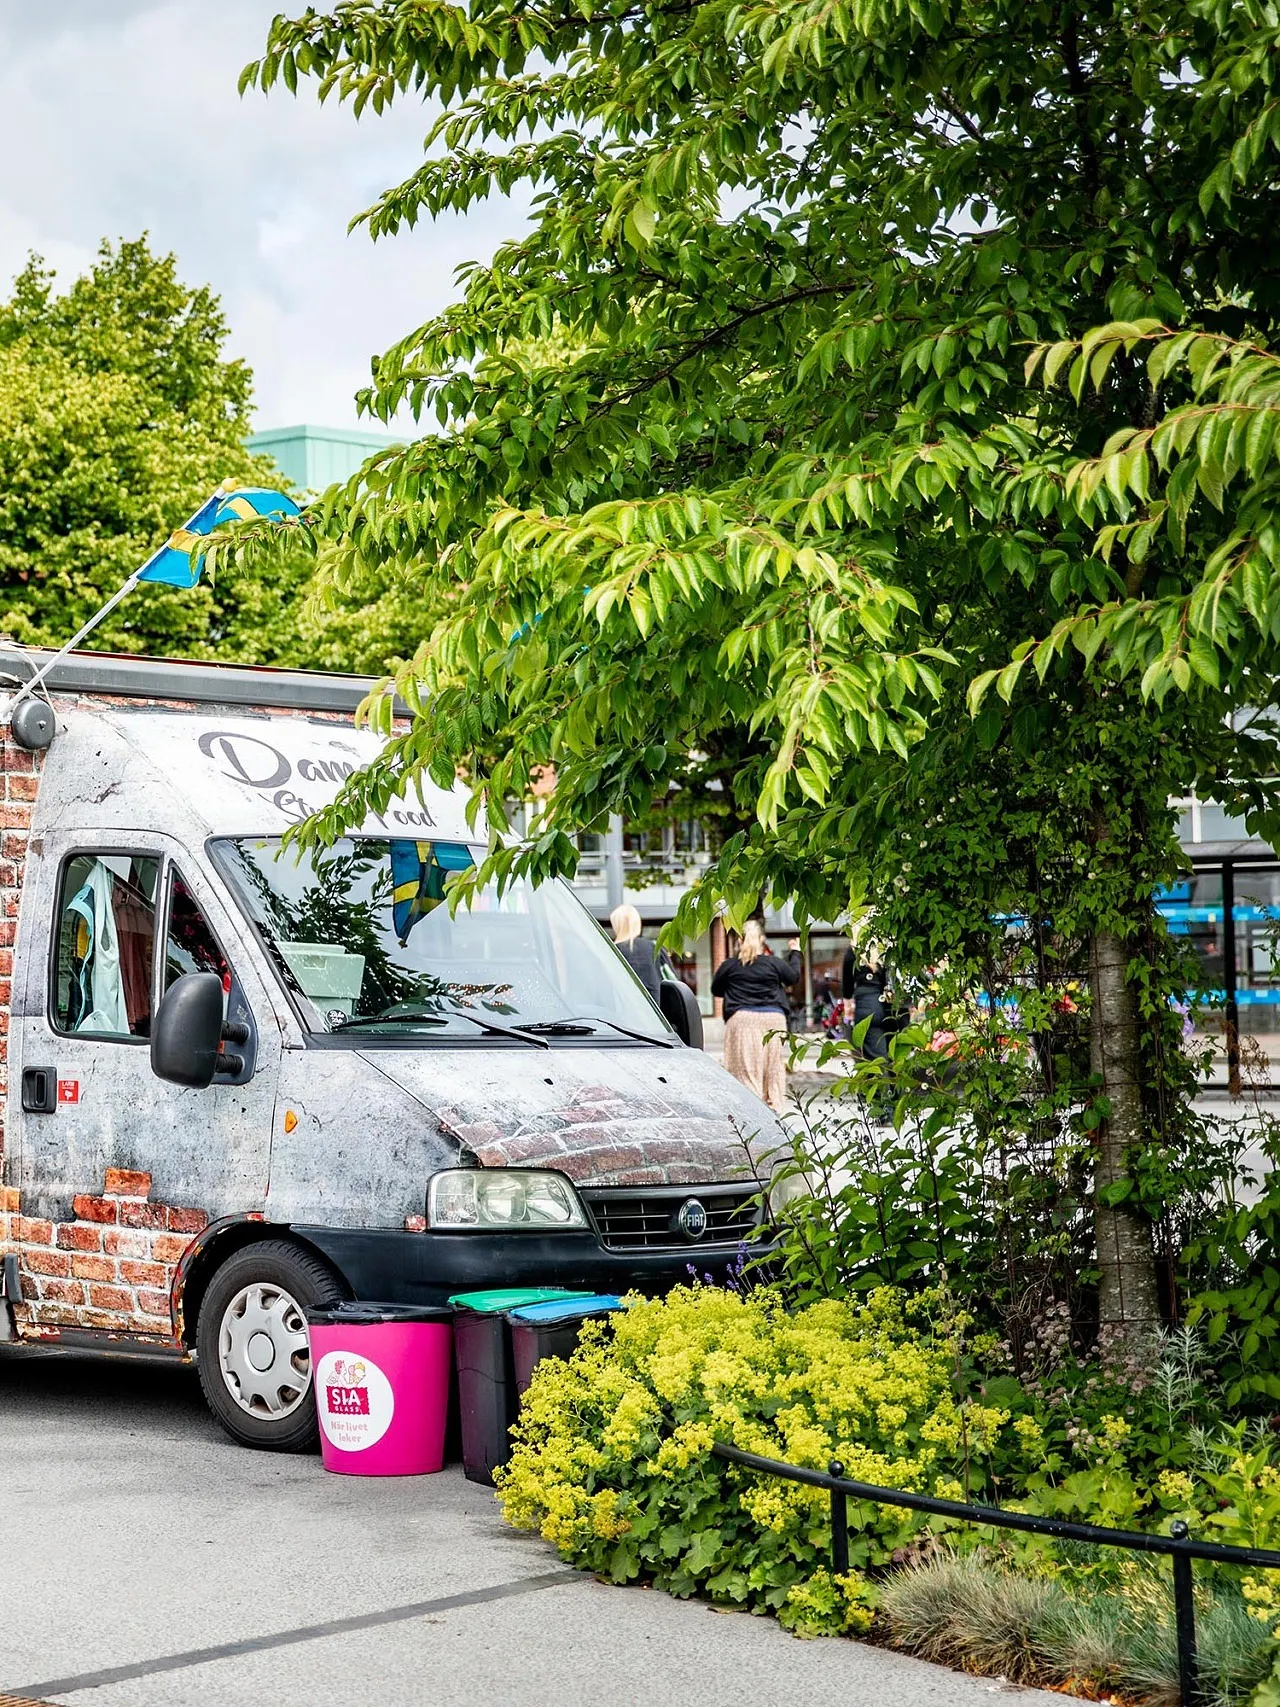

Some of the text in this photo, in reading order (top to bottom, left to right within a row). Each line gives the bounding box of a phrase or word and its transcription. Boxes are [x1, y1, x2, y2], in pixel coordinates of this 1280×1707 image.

[198, 731, 372, 789] Dam
[687, 1214, 704, 1227] FIAT
[331, 1388, 362, 1406] SIA
[331, 1420, 368, 1431] När livet
[338, 1432, 361, 1442] leker
